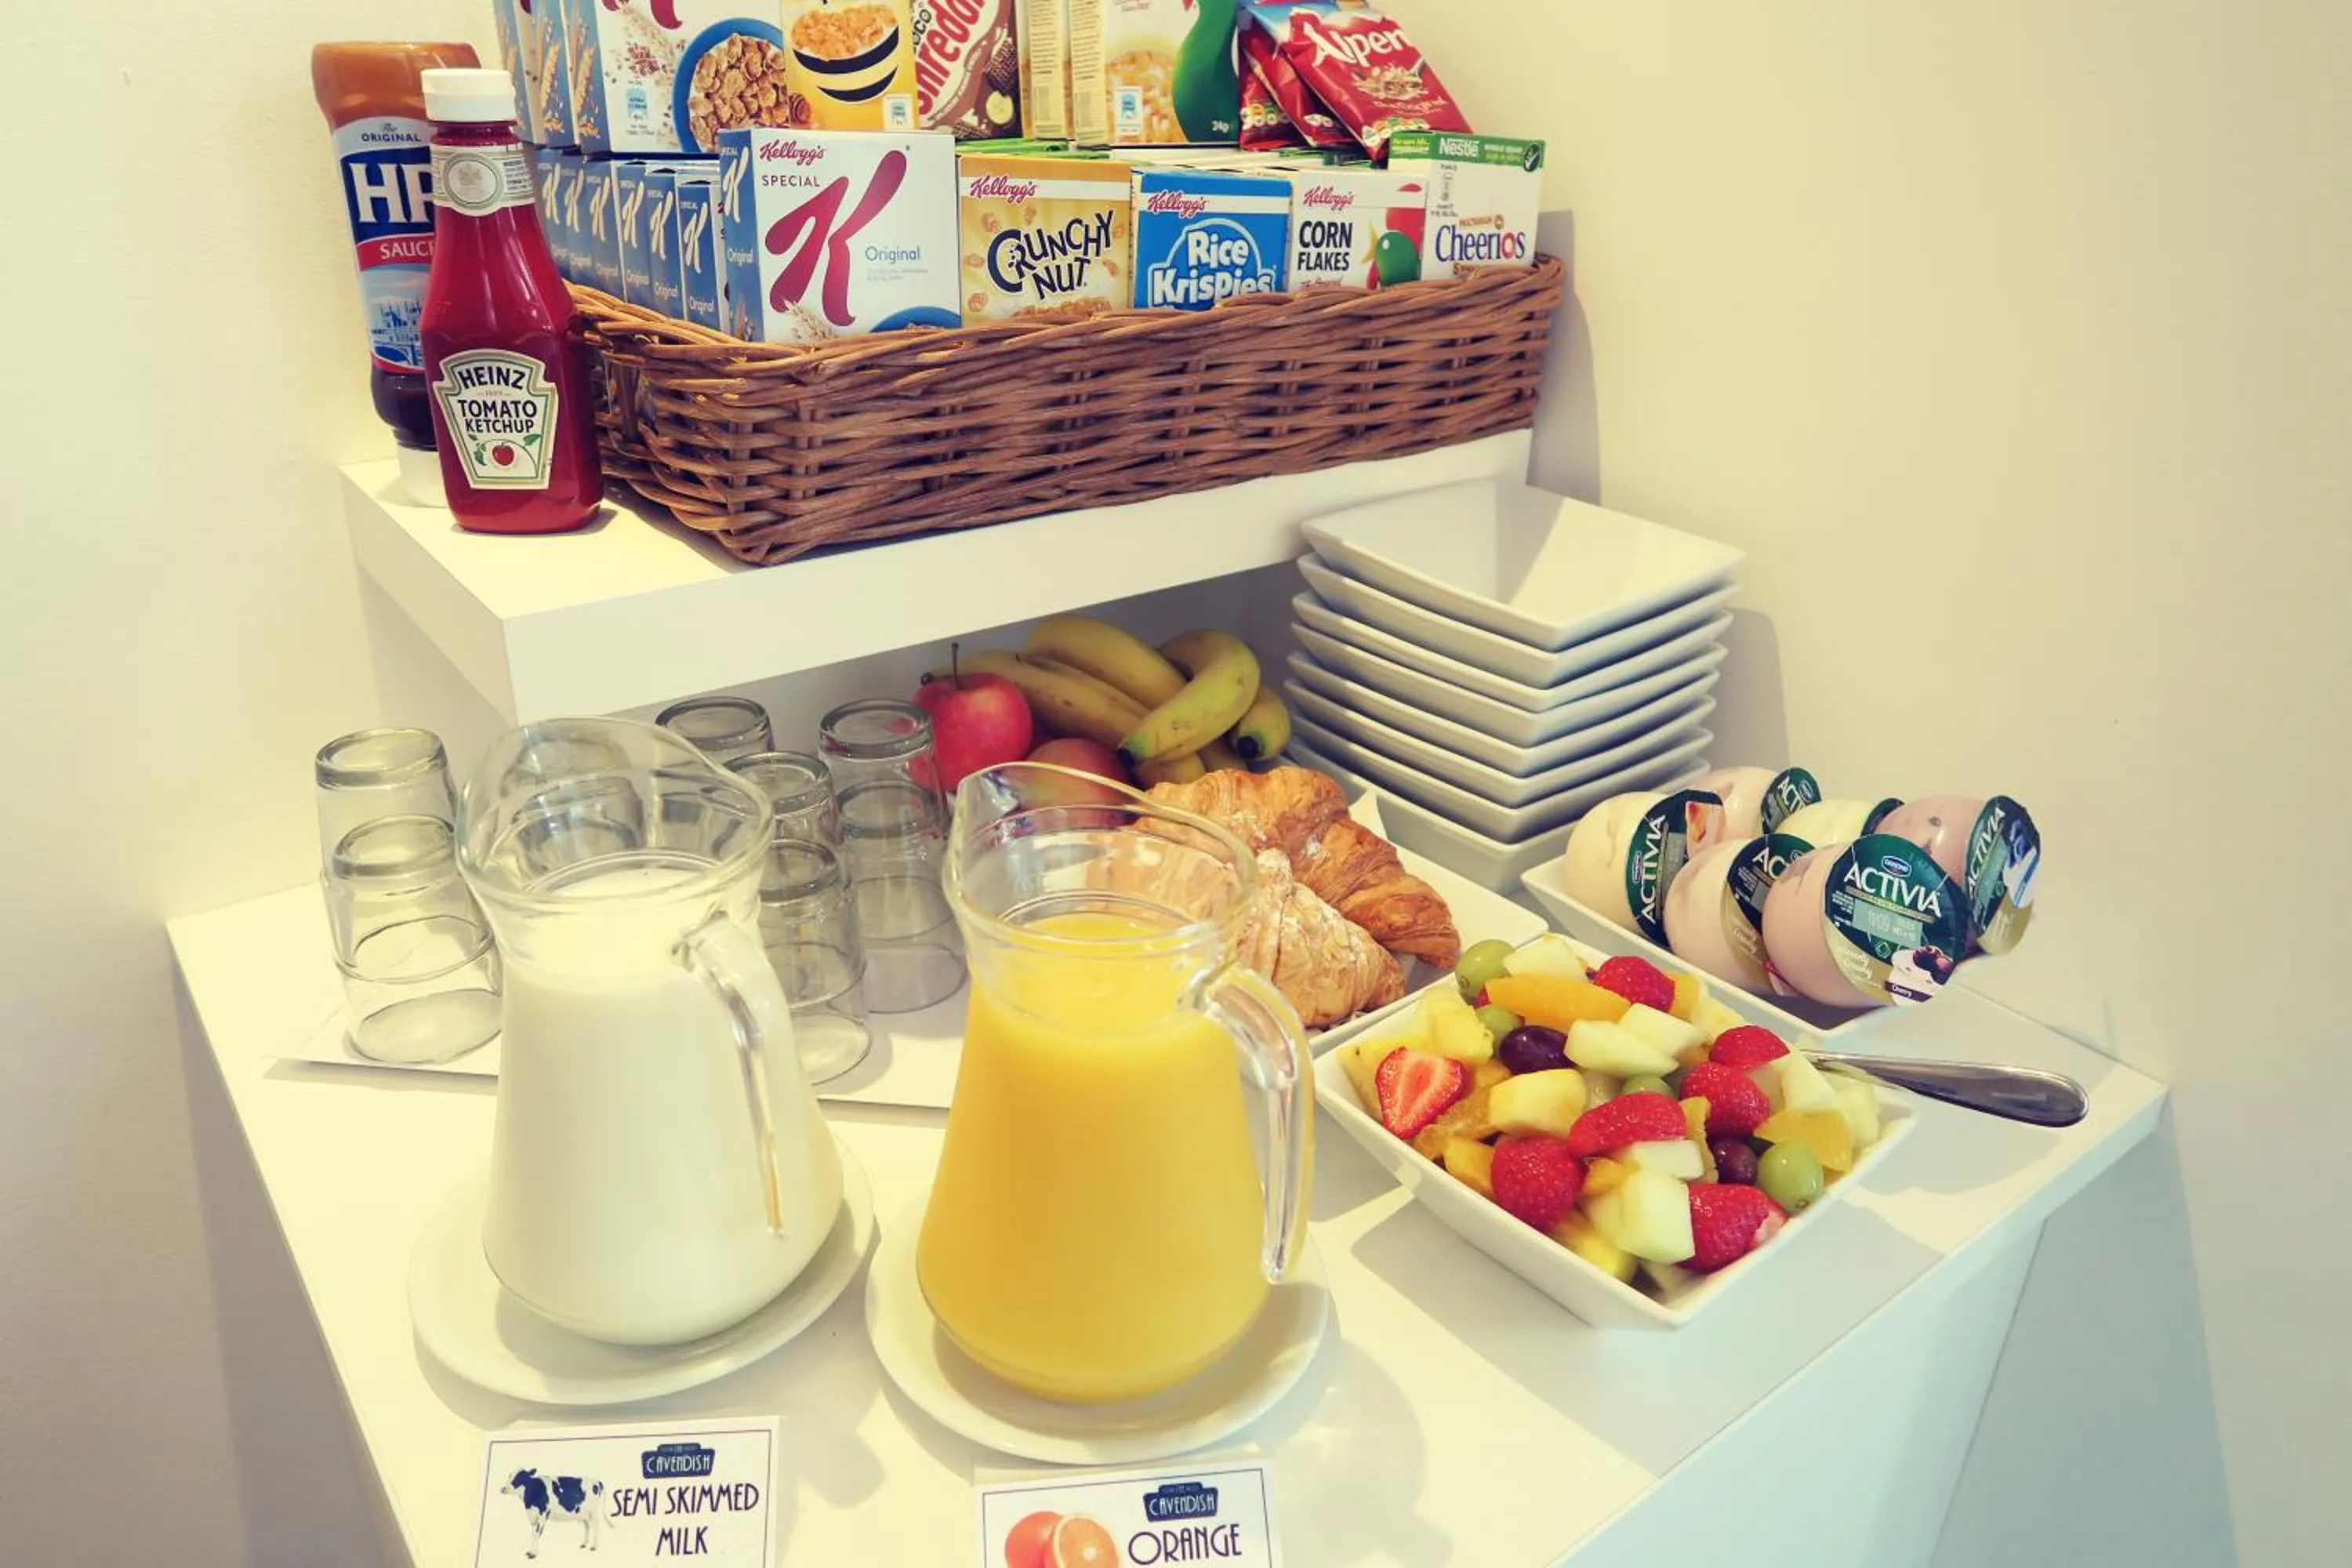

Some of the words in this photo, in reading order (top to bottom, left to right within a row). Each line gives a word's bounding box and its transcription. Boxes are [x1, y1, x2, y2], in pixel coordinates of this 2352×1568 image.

[1304, 21, 1414, 67] Alpen
[361, 133, 422, 143] ORIGINAL
[760, 140, 826, 165] Kellogg's
[762, 176, 821, 187] SPECIAL
[971, 176, 1038, 203] Kellogg's
[1148, 191, 1207, 217] Kellogg's
[1304, 186, 1353, 210] Kellogg's
[765, 150, 907, 326] K
[1299, 221, 1352, 249] CORN
[1436, 225, 1525, 262] Cheerios
[727, 248, 753, 266] Original
[866, 246, 920, 263] Original
[987, 210, 1113, 293] CRUNCHY
[1188, 230, 1249, 268] Rice
[1298, 252, 1349, 270] FLAKES
[1032, 257, 1091, 299] NUT
[1152, 268, 1272, 305] Krispies
[689, 296, 714, 314] Original
[458, 366, 525, 390] HEINZ
[458, 400, 537, 418] TOMATO
[465, 419, 534, 434] KETCHUP
[1967, 807, 2005, 900] ACTIVIA
[1641, 815, 1666, 924] ACTIVIA
[1844, 862, 1942, 917] ACTIVIA
[1892, 983, 1912, 997] Cherry
[646, 1454, 710, 1473] CAVENDISH
[611, 1487, 657, 1517] SEMI
[665, 1483, 759, 1515] SKIMMED
[1149, 1494, 1215, 1515] CAVENDISH
[655, 1526, 708, 1556] MILK
[1128, 1523, 1242, 1566] ORANGE
